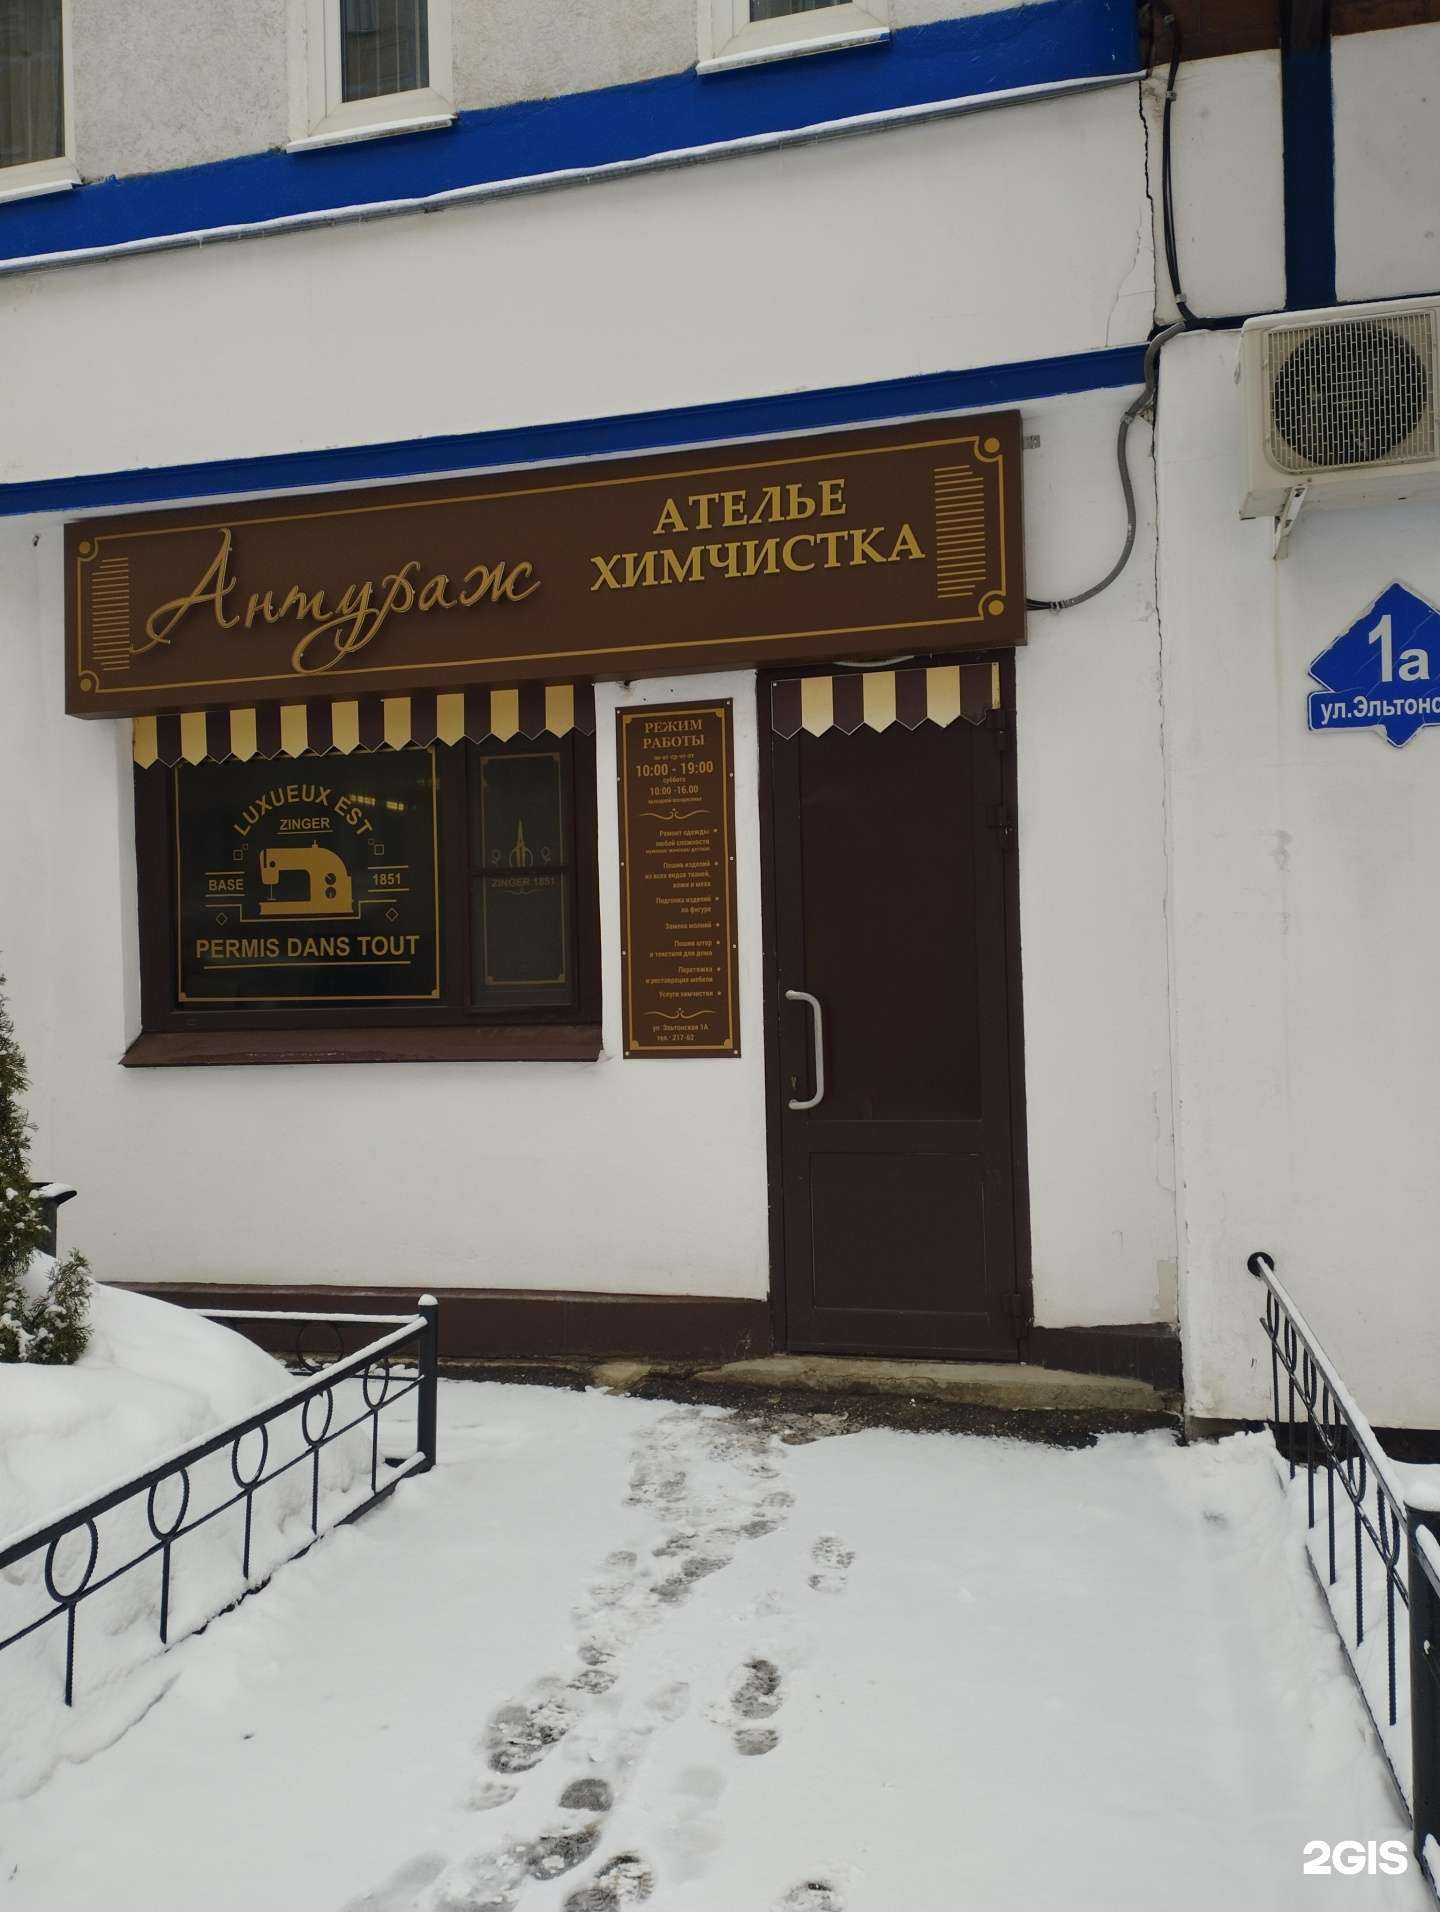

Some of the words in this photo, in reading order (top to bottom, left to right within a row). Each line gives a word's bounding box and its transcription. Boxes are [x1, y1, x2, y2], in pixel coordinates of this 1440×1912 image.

[653, 477, 848, 536] АТЕЛЬЕ
[589, 522, 926, 593] ХИМЧИСТКА
[129, 527, 541, 674] Антураж
[1368, 614, 1430, 682] 1а
[644, 719, 703, 733] РЕЖИМ
[643, 734, 705, 749] РАБОТЫ
[636, 763, 669, 777] 10:00
[680, 760, 714, 774] 19:00
[650, 786, 671, 797] 10:00
[233, 783, 332, 837] LUXUEUX
[333, 796, 373, 837] EST
[279, 816, 331, 832] ZINGER
[208, 878, 245, 892] BASE
[372, 872, 402, 886] 1851
[195, 937, 281, 960] PERMIS
[286, 936, 351, 958] DANS
[356, 935, 421, 957] TOUT
